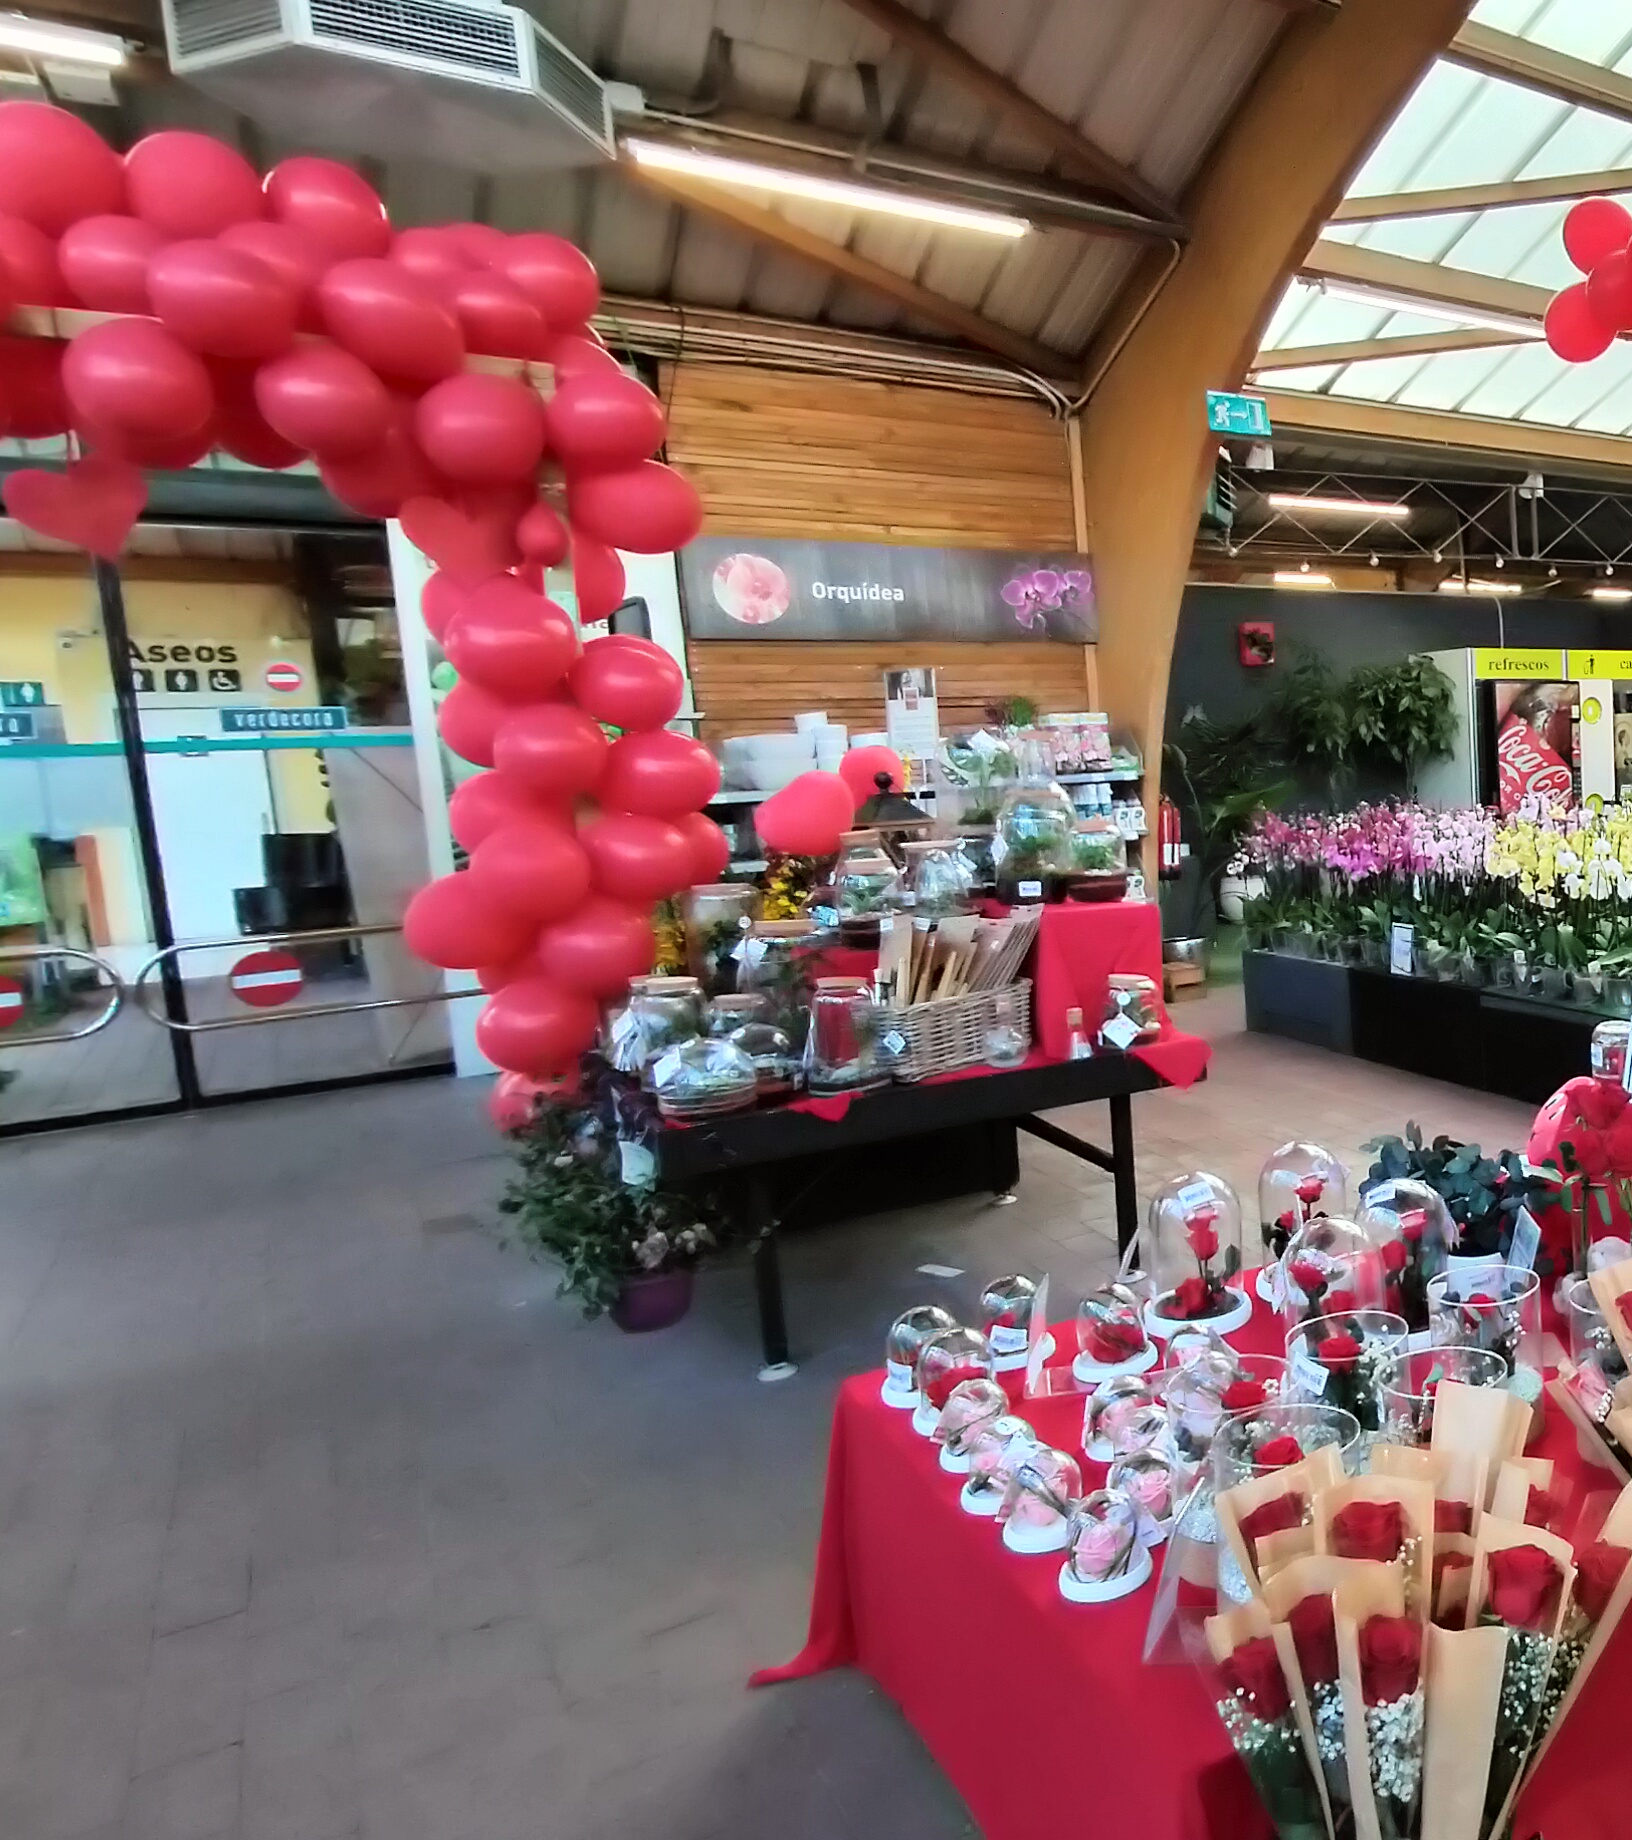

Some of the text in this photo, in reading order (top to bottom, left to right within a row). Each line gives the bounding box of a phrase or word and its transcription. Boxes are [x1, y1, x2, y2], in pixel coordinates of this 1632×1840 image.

[812, 582, 904, 603] Orquídea
[126, 638, 238, 664] Aseos
[1488, 658, 1550, 672] refrescos
[234, 711, 333, 728] verdecora
